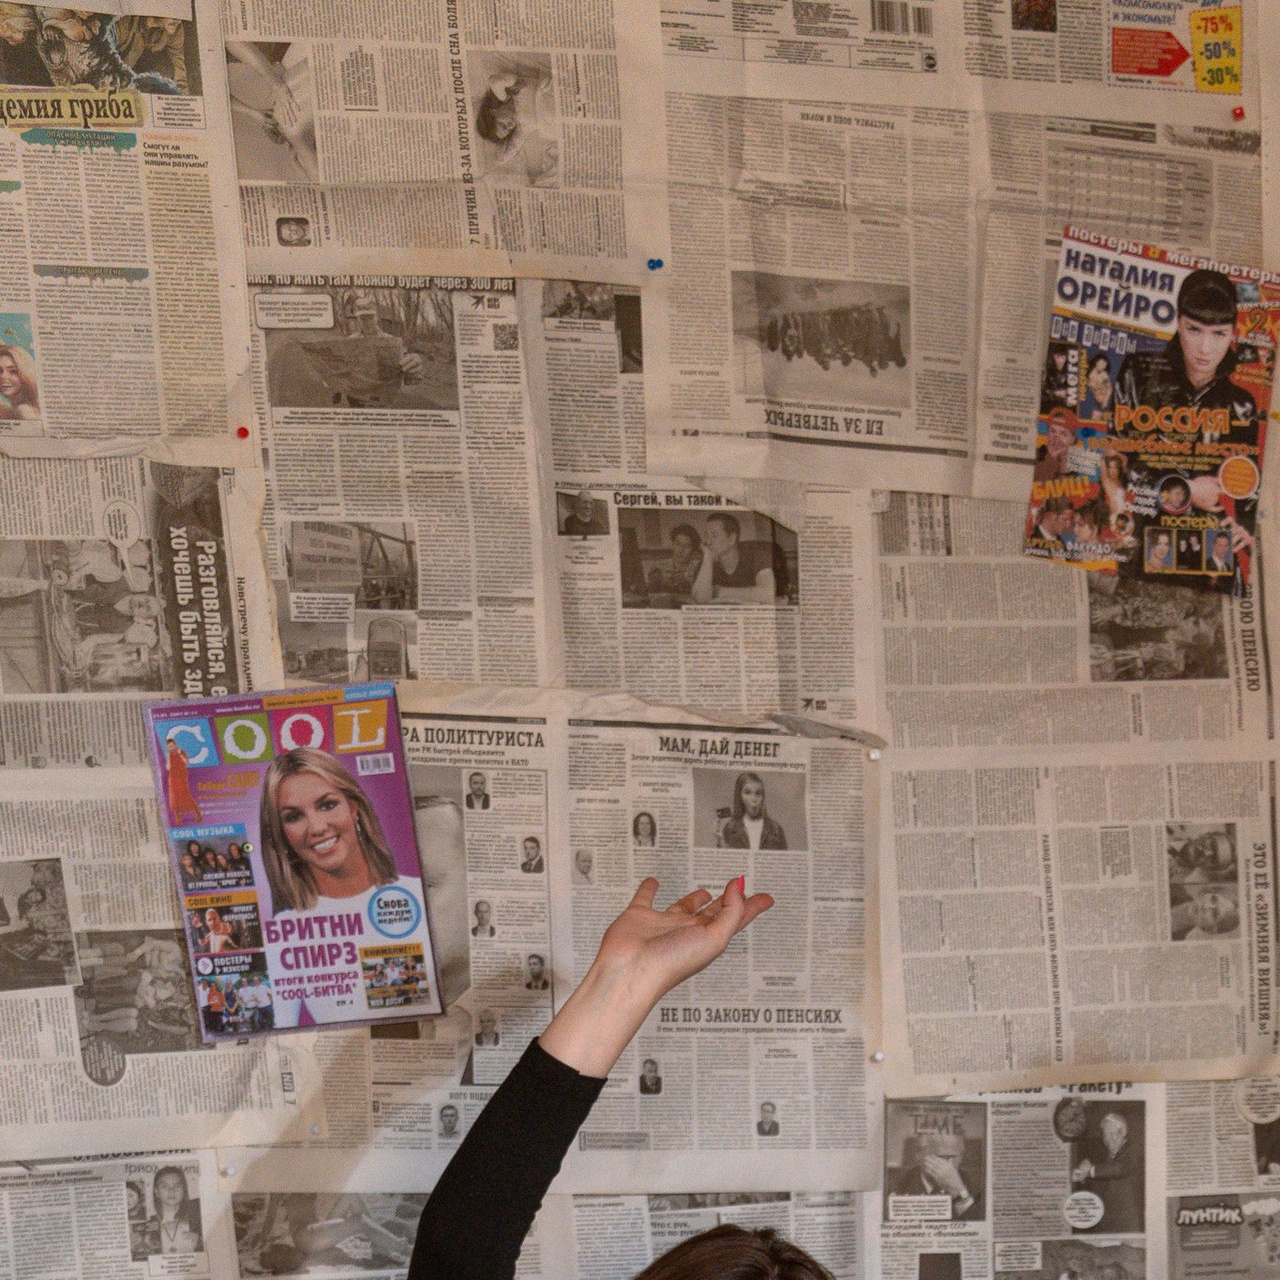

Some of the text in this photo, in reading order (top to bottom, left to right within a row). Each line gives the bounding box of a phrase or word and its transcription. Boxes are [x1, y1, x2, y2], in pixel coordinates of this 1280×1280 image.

[1196, 15, 1233, 34] -75%
[1199, 40, 1237, 60] -50%
[1201, 67, 1239, 86] -30%
[449, 31, 470, 150] КОТОРЫХ ПОСЛЕ СНА
[70, 88, 134, 128] гриба
[353, 275, 397, 288] можно
[434, 276, 468, 290] через
[470, 277, 492, 291] 300
[493, 278, 515, 292] лет
[1057, 274, 1176, 325] ОРЕЙРО
[764, 409, 841, 434] ЧЕТВЕРЫХ
[843, 417, 863, 435] ЗА
[1115, 404, 1230, 435] РОССИЯ
[613, 491, 663, 507] Сергей,
[666, 494, 683, 506] вы
[169, 526, 202, 664] хочешь быть
[236, 577, 250, 637] Навстречу
[196, 540, 227, 680] Разговляйся,
[1243, 631, 1261, 693] ПЕНСИЮ
[166, 708, 386, 766] COOL
[424, 727, 545, 749] ПОЛИТТУРИСТА
[658, 736, 781, 759] МАМ, ДАЙ ДЕНЕГ
[1253, 842, 1266, 875] ЭТО
[376, 897, 410, 910] Снова
[264, 912, 364, 946] БРИТНИ
[279, 941, 358, 971] СПИРЗ
[274, 970, 359, 987] итоги конкурса
[276, 982, 357, 1001] "COOL-БИТВА"
[660, 1007, 842, 1025] НЕ ПО ЗАКОНУ О ПЕНСИЯХ
[1176, 1204, 1243, 1227] ЛУНТИК
